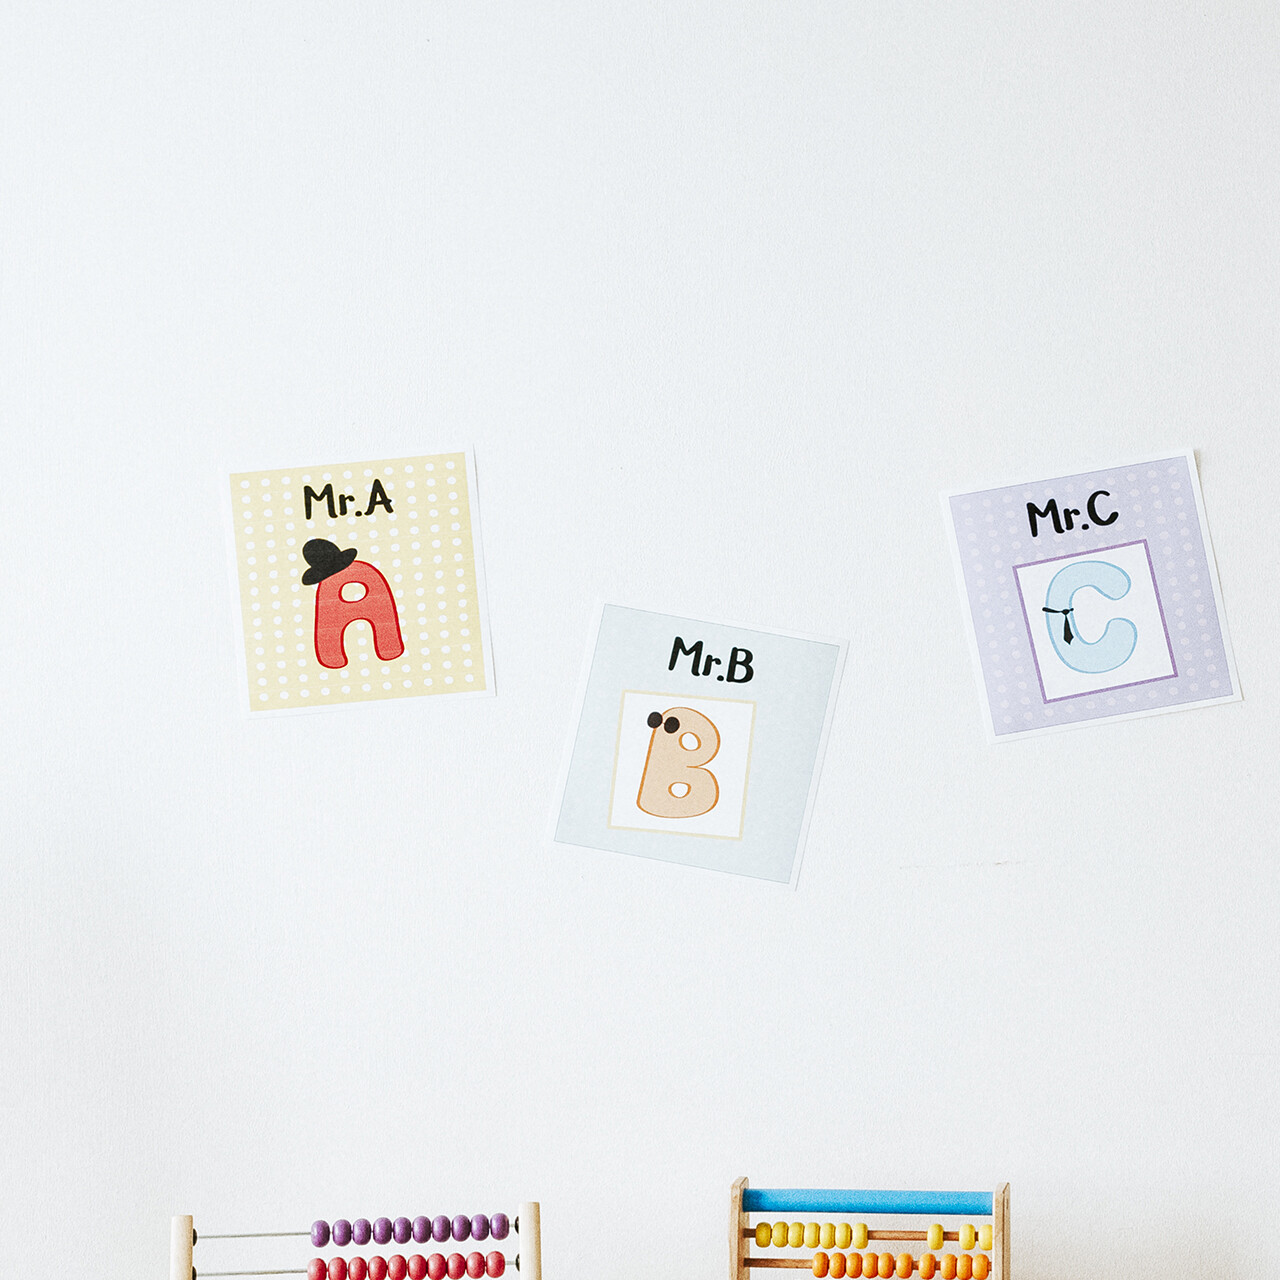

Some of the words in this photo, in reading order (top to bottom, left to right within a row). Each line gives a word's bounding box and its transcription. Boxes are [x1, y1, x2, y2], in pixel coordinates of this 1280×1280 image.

[304, 479, 393, 519] Mr.A
[1027, 491, 1118, 537] Mr.C
[1045, 560, 1138, 674] C
[669, 637, 753, 683] Mr.B
